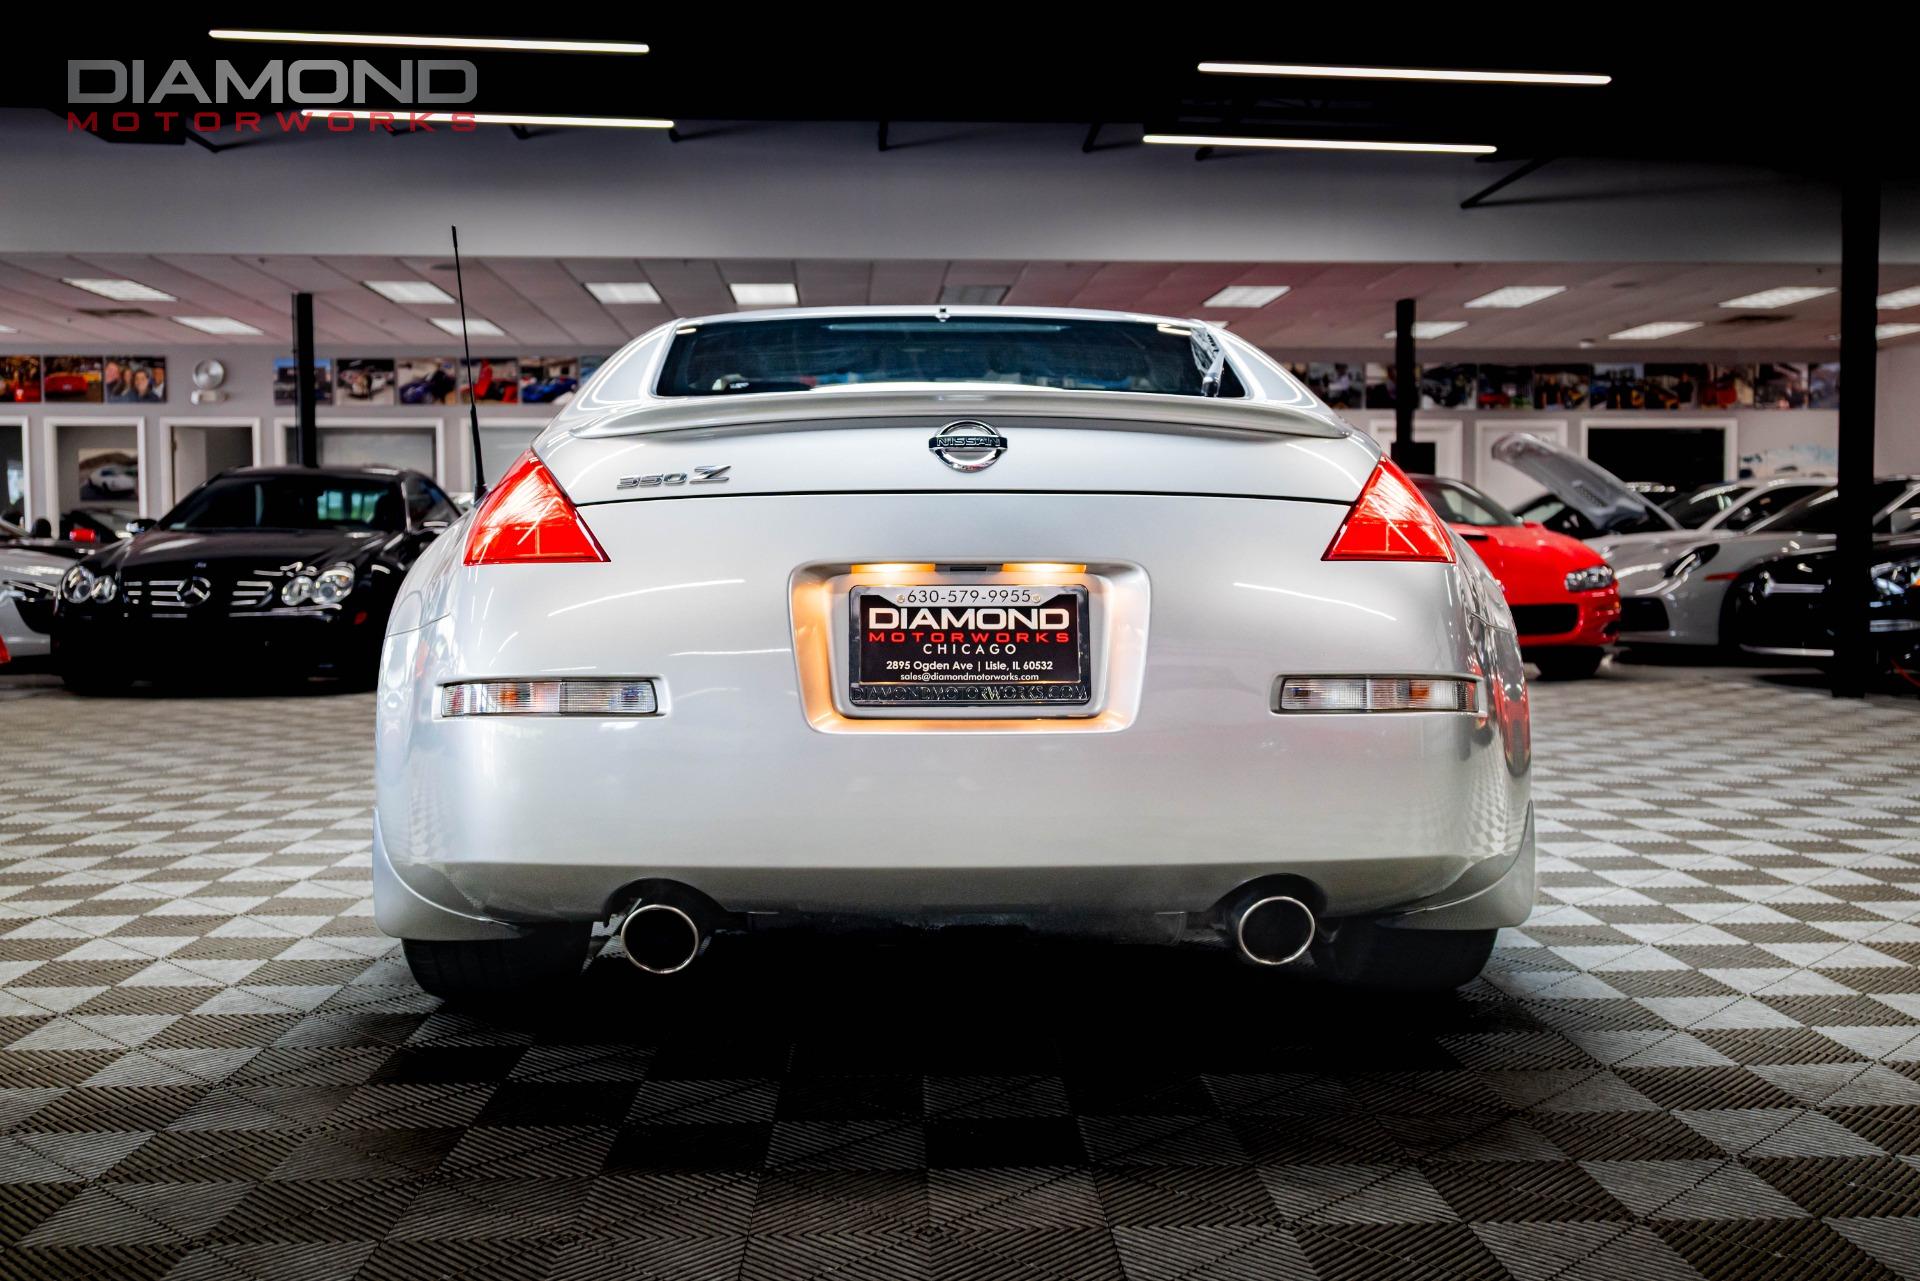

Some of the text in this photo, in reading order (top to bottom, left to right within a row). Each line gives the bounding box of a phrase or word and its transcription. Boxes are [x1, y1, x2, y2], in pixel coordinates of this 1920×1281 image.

[936, 437, 1001, 447] NISSAN
[907, 589, 1032, 604] 630-579-9955
[868, 607, 1070, 630] DIAMOND
[868, 632, 1070, 643] MOTORWORKS
[922, 643, 1017, 655] CHICAGO
[886, 660, 911, 670] 2895
[913, 660, 950, 672] Ogden
[952, 660, 974, 670] Ave
[985, 660, 1010, 672] Lisle,
[1012, 660, 1021, 670] IL
[1023, 660, 1053, 670] 60532
[900, 672, 1039, 681] sales@diamondmotorworks.com
